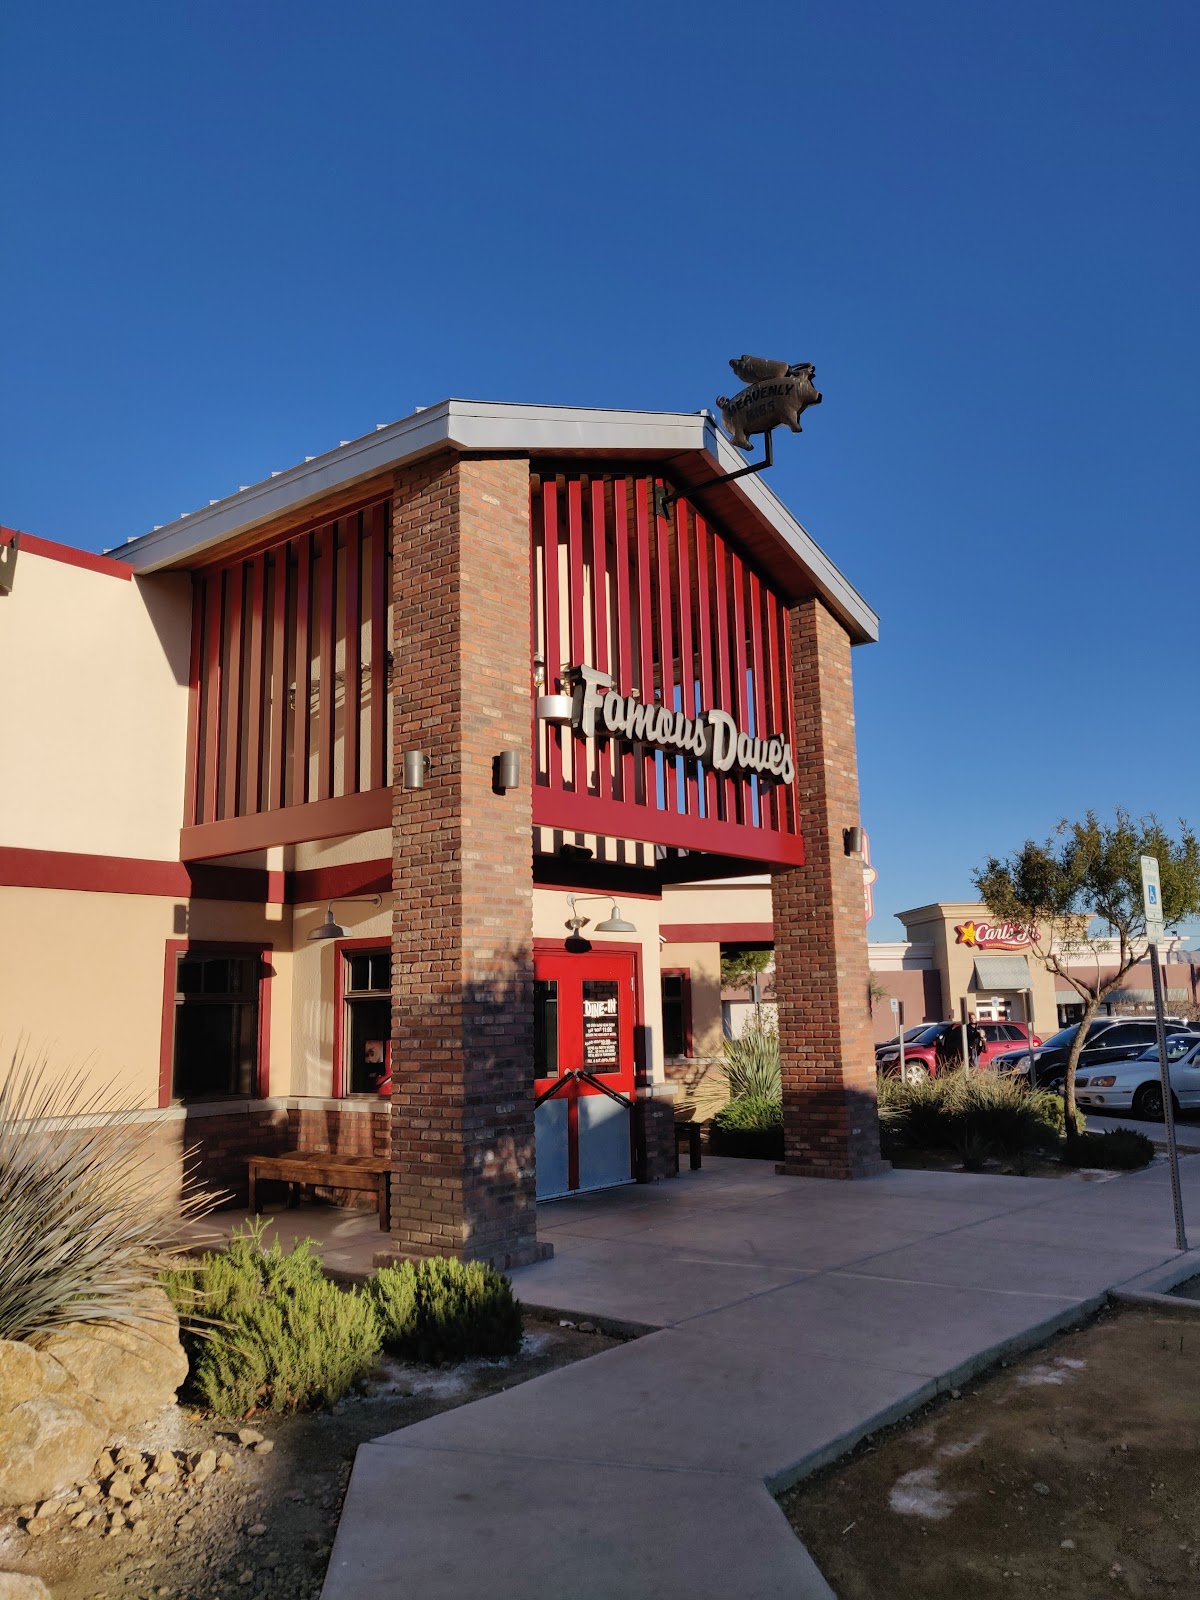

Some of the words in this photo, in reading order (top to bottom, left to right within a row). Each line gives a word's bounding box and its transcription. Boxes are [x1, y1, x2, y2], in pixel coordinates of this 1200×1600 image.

[579, 664, 707, 757] Famous
[708, 709, 795, 784] Dave's
[975, 924, 1014, 942] Carl's
